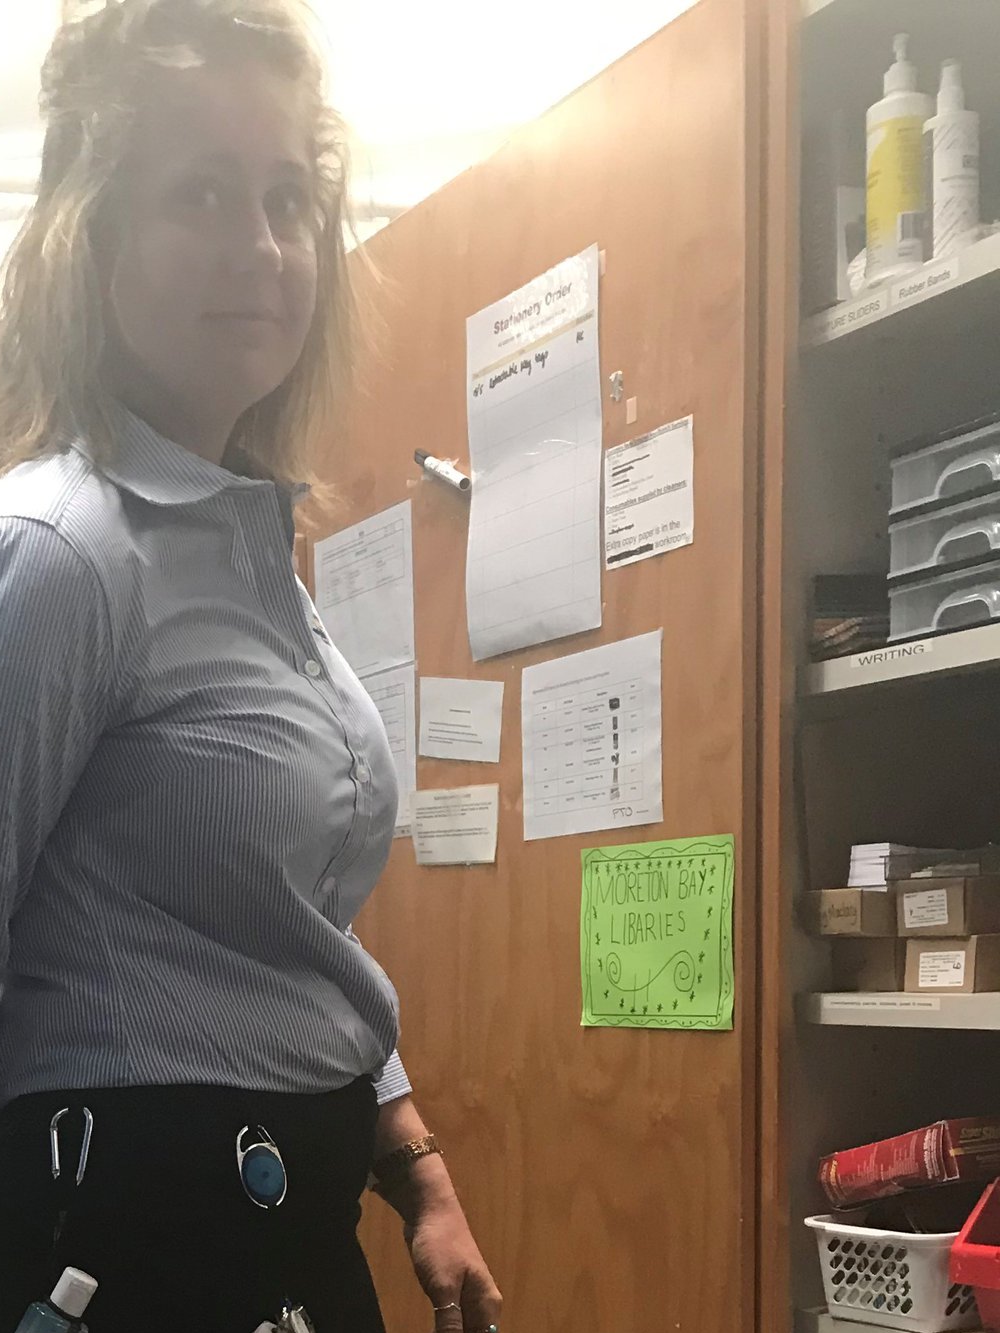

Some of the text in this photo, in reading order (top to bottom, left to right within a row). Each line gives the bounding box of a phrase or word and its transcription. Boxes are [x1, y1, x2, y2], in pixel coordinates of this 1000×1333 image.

[899, 269, 951, 299] Rubber Bands
[494, 300, 541, 334] Stationery
[545, 283, 572, 306] Order
[606, 540, 621, 551] Extra
[622, 535, 637, 546] copy
[638, 529, 653, 541] paper
[669, 520, 681, 530] the
[858, 644, 924, 666] WRITING
[612, 807, 633, 819] PTO
[598, 869, 708, 905] MORETON BAY
[611, 912, 686, 945] LIBARIES
